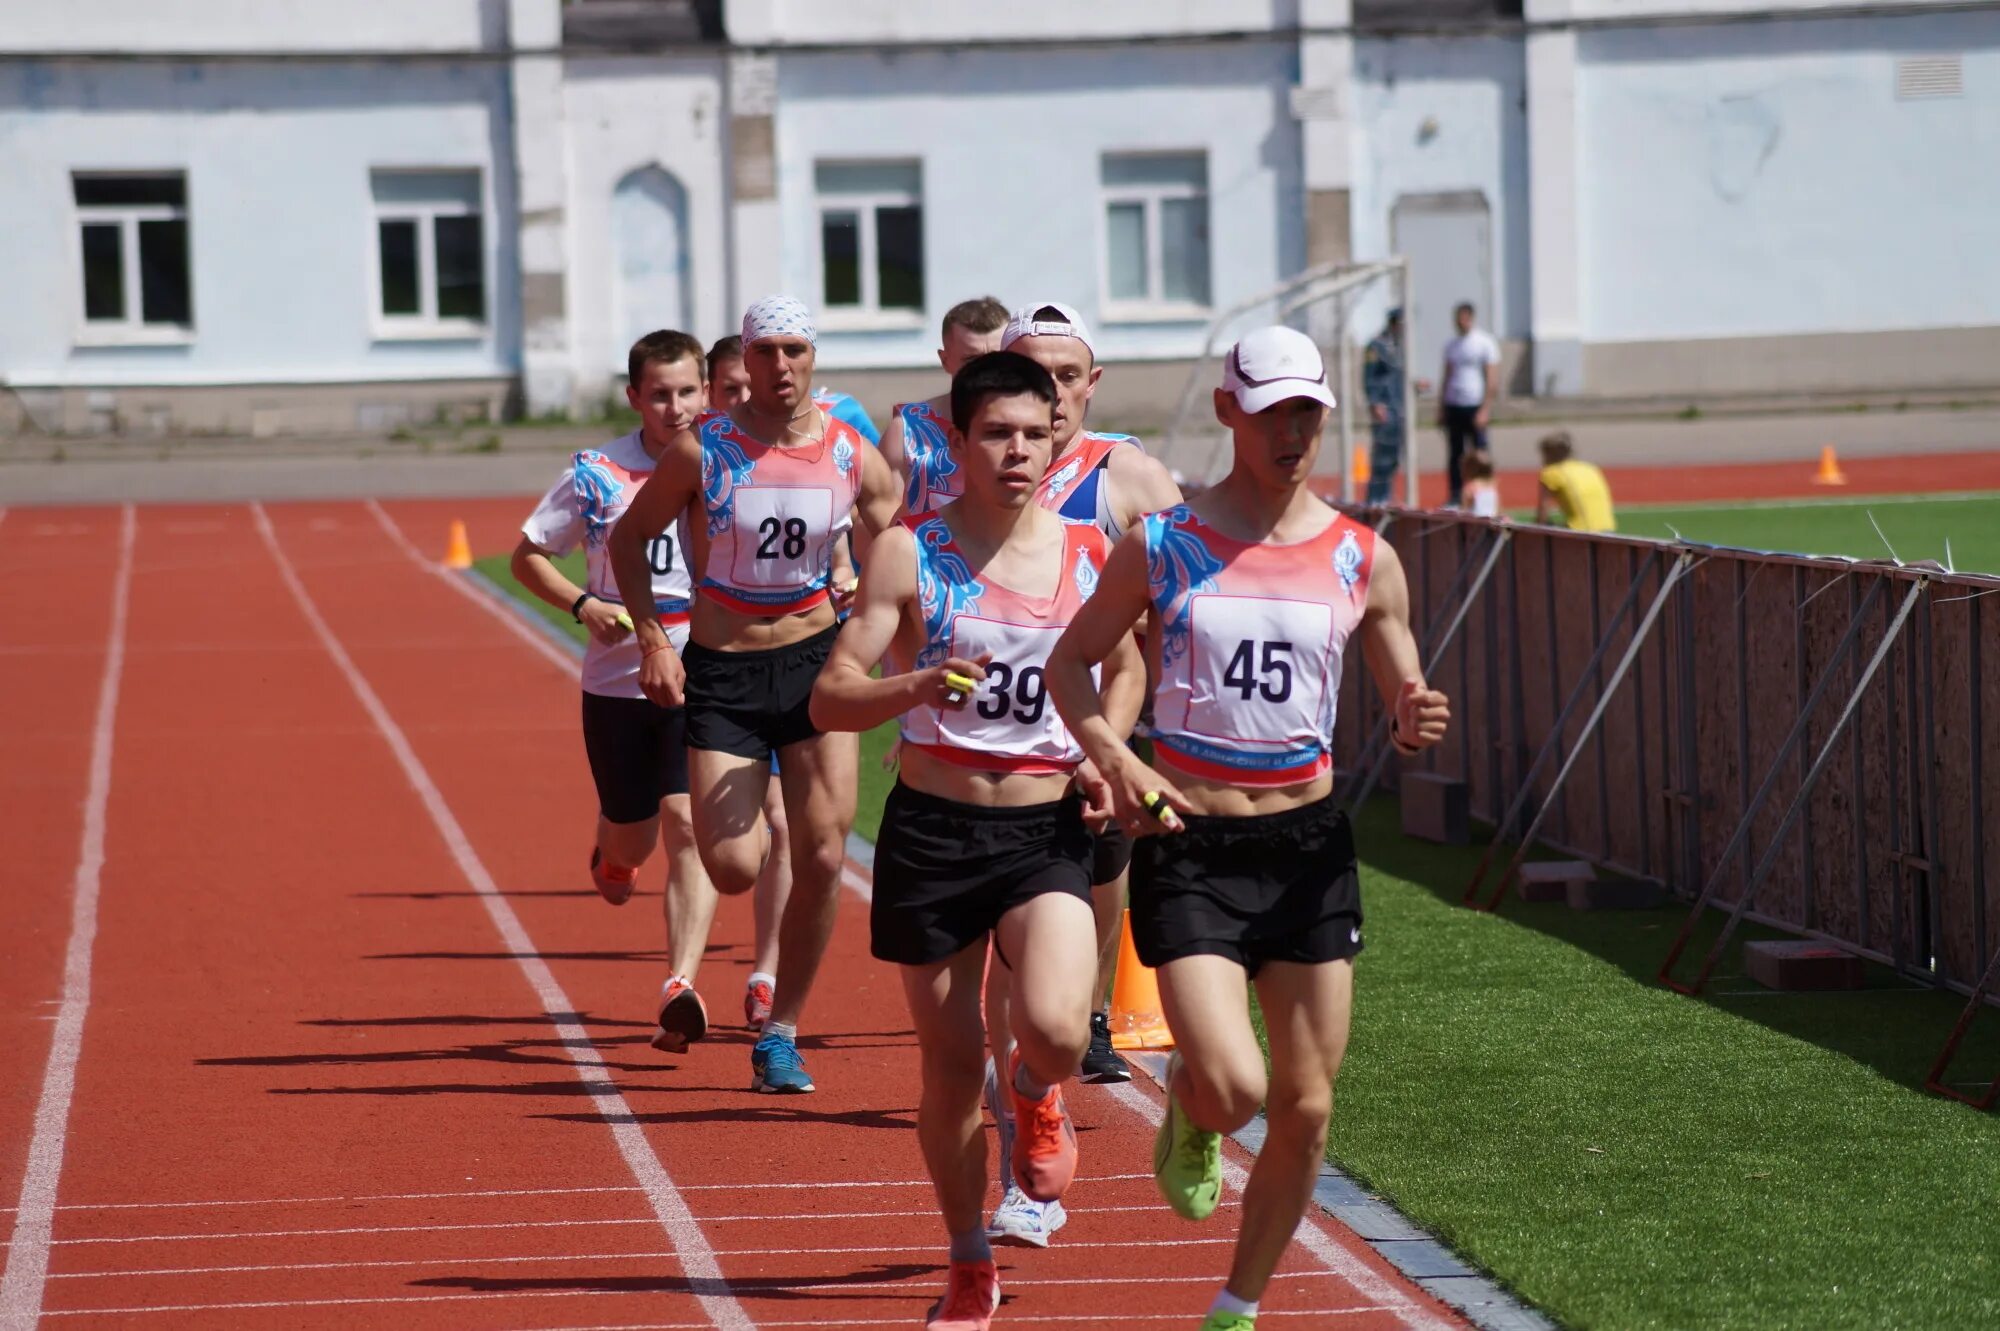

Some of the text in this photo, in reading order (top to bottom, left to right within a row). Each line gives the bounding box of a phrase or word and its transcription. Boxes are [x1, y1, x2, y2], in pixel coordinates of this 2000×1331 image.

[650, 534, 674, 575] 0
[756, 517, 808, 560] 28
[976, 662, 1047, 725] 39
[1223, 640, 1293, 703] 45
